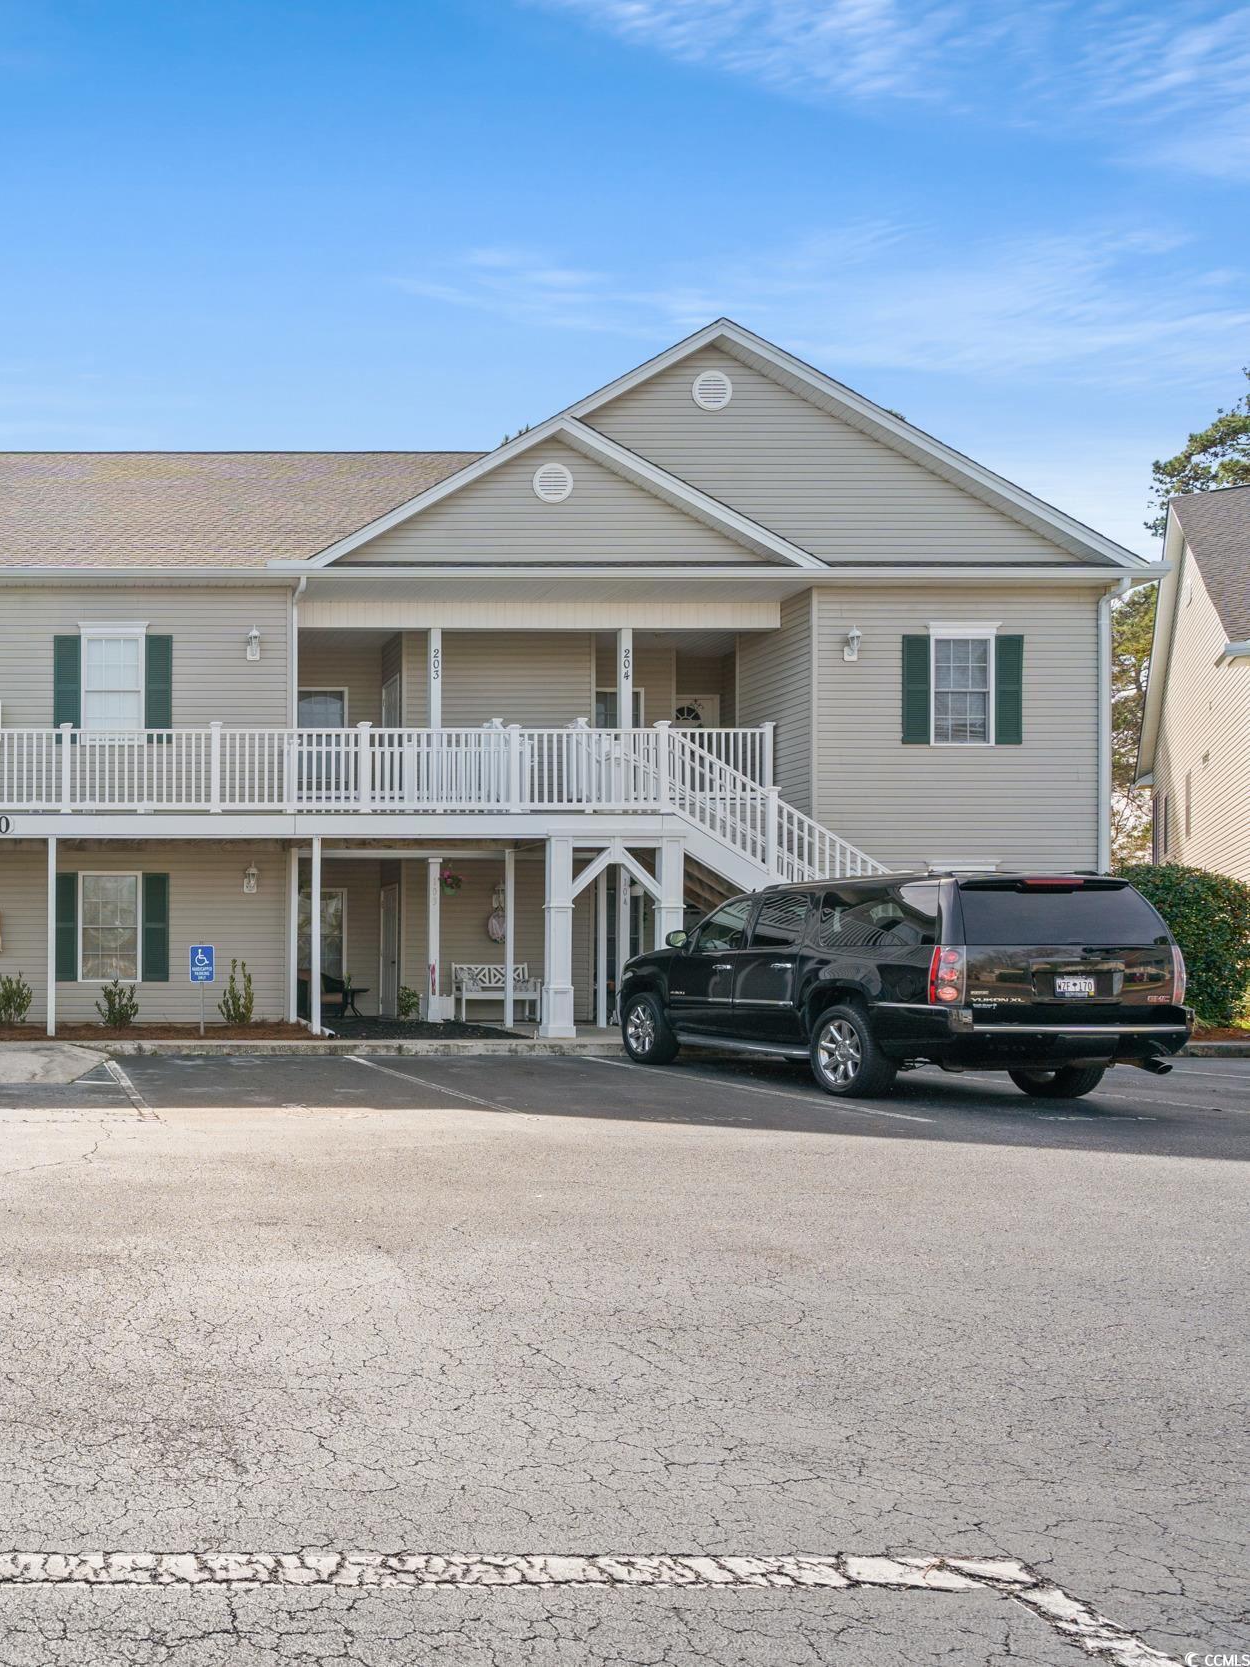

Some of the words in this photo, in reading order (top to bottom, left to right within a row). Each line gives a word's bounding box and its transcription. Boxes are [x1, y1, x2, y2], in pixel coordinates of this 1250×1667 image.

[432, 648, 440, 680] 203
[623, 648, 631, 681] 204
[1057, 981, 1071, 991] WZF
[1078, 981, 1093, 991] 170
